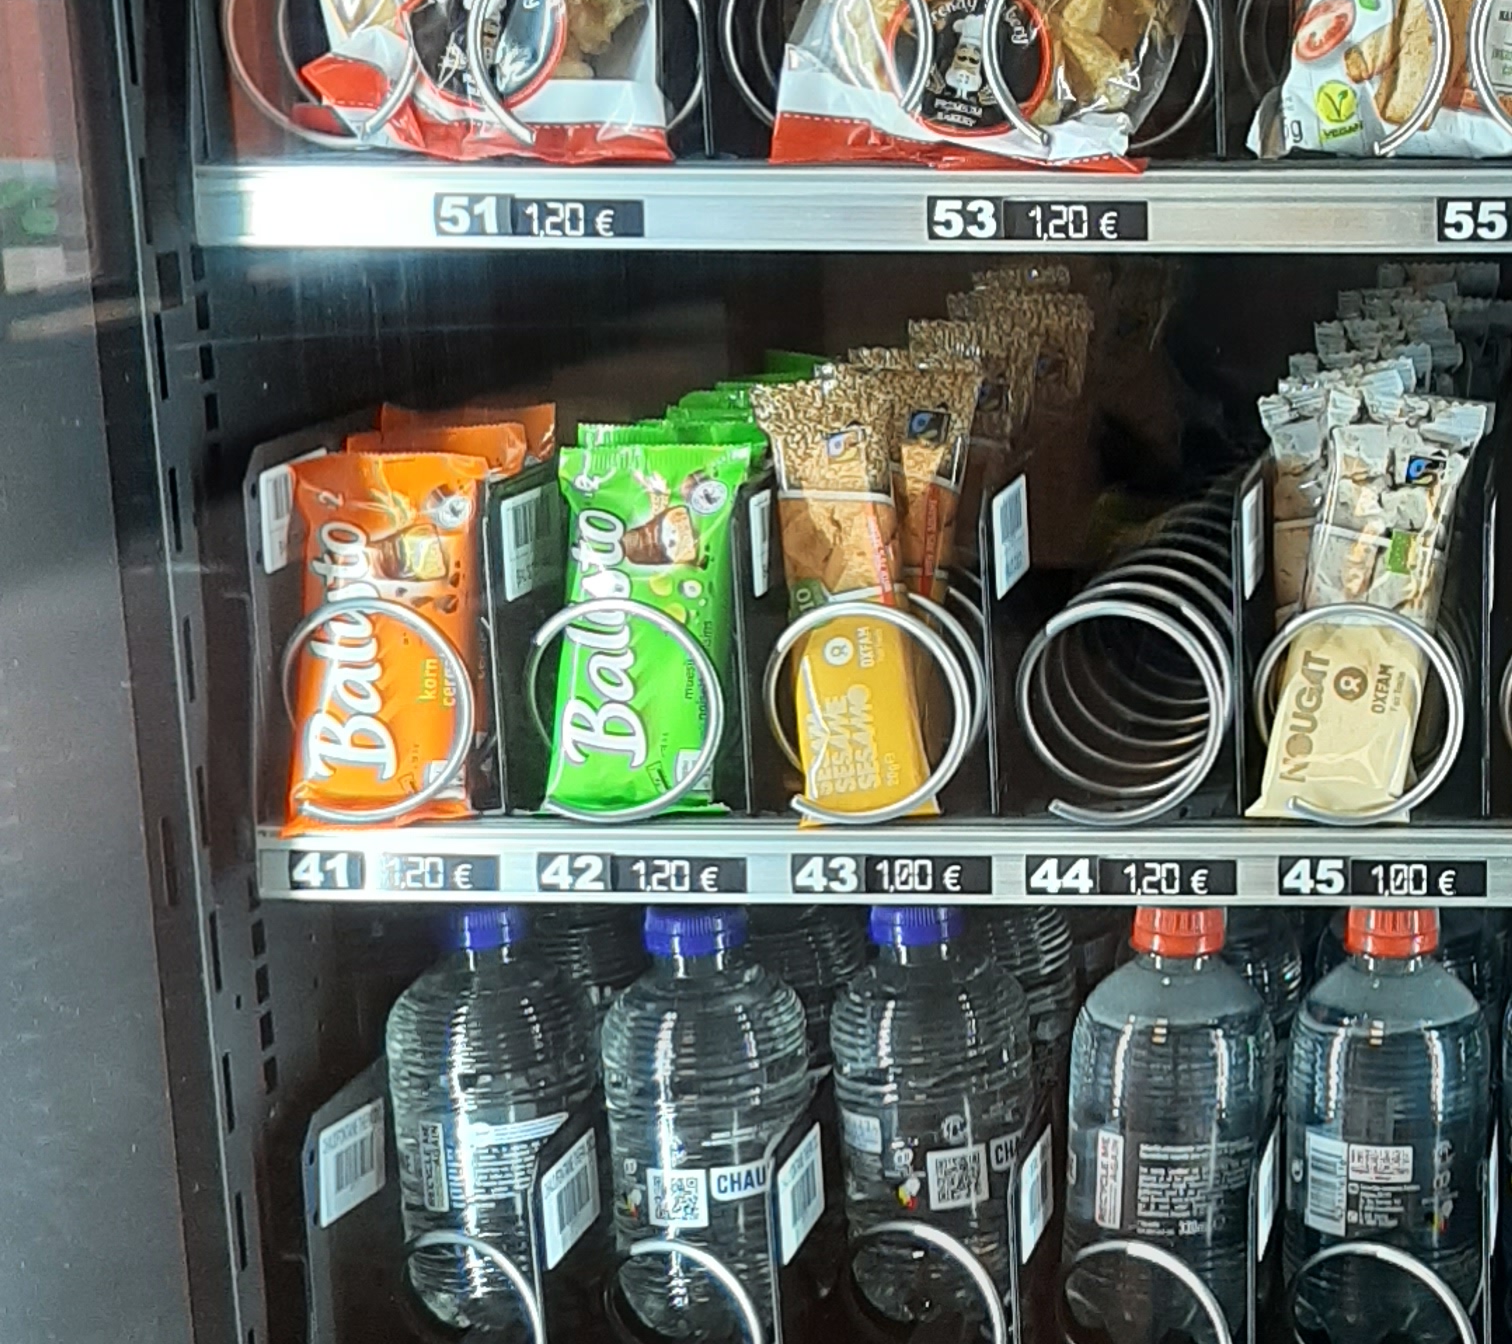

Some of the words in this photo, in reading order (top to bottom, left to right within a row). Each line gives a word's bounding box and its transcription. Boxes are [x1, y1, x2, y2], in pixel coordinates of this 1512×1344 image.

[438, 195, 499, 234] 51
[932, 199, 998, 240] 53
[1028, 205, 1088, 242] 1,20
[1100, 210, 1119, 239] €
[1443, 200, 1508, 241] 55
[302, 521, 399, 782] Balisto
[560, 509, 650, 769] Balisto
[858, 625, 876, 668] OXFAM
[417, 658, 439, 702] korn
[1370, 663, 1395, 715] OXFAM
[1279, 649, 1331, 784] NOUGAT
[291, 854, 349, 888] 41
[539, 855, 607, 891] 42
[794, 857, 859, 892] 43
[1029, 858, 1094, 893] 44
[1123, 862, 1180, 896] 1,20
[1191, 867, 1209, 895] €
[1282, 858, 1345, 894] 45
